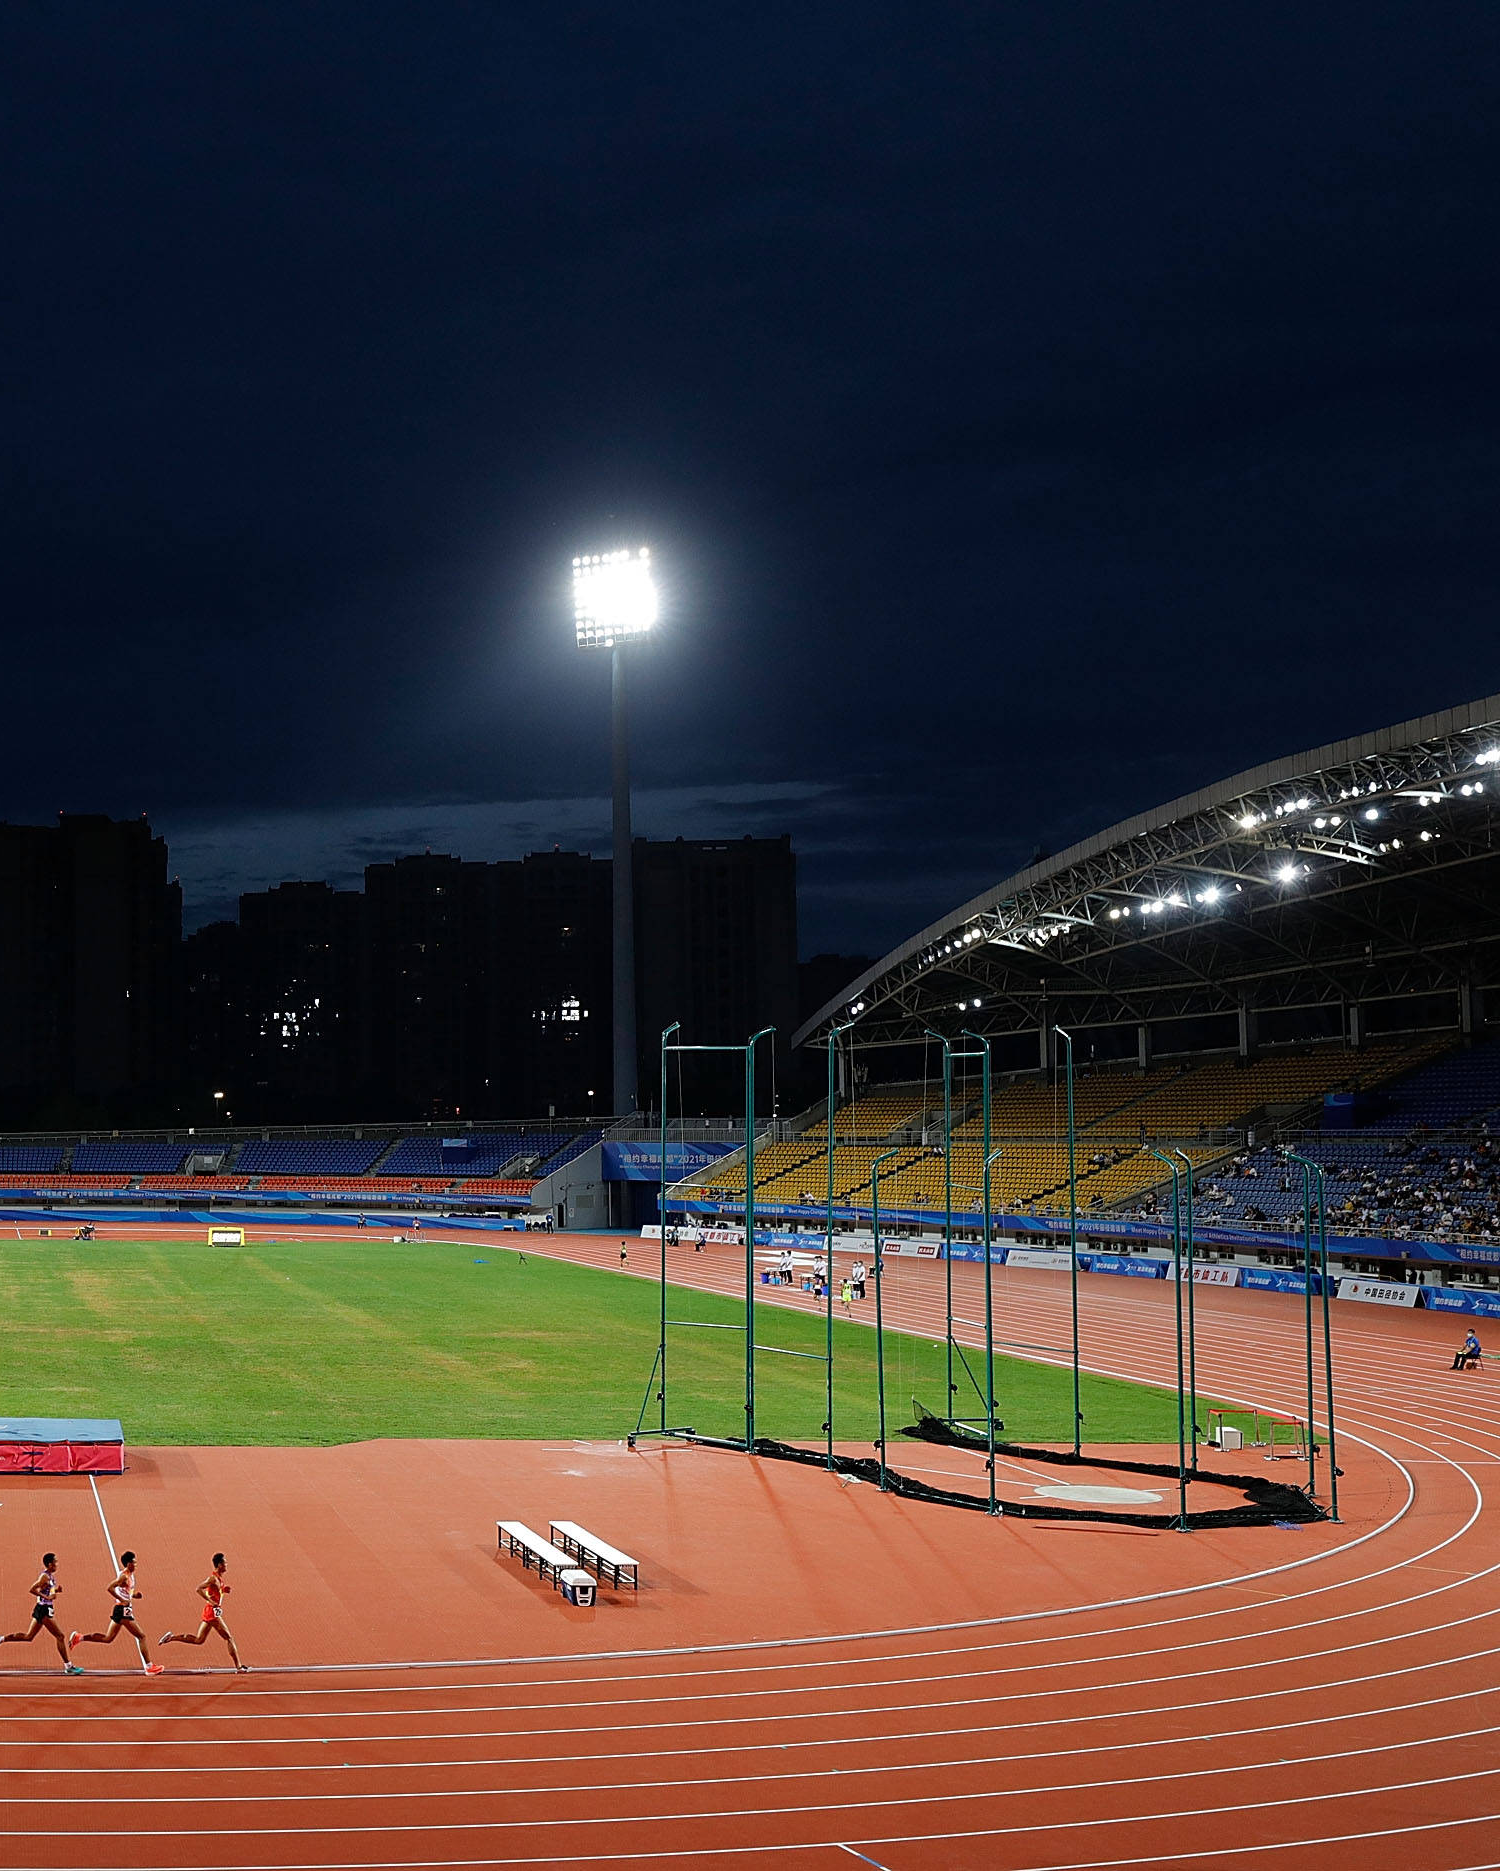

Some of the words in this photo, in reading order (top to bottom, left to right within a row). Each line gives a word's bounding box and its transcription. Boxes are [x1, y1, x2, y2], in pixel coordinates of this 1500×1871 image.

[1364, 1288, 1406, 1301] 中国田径协会
